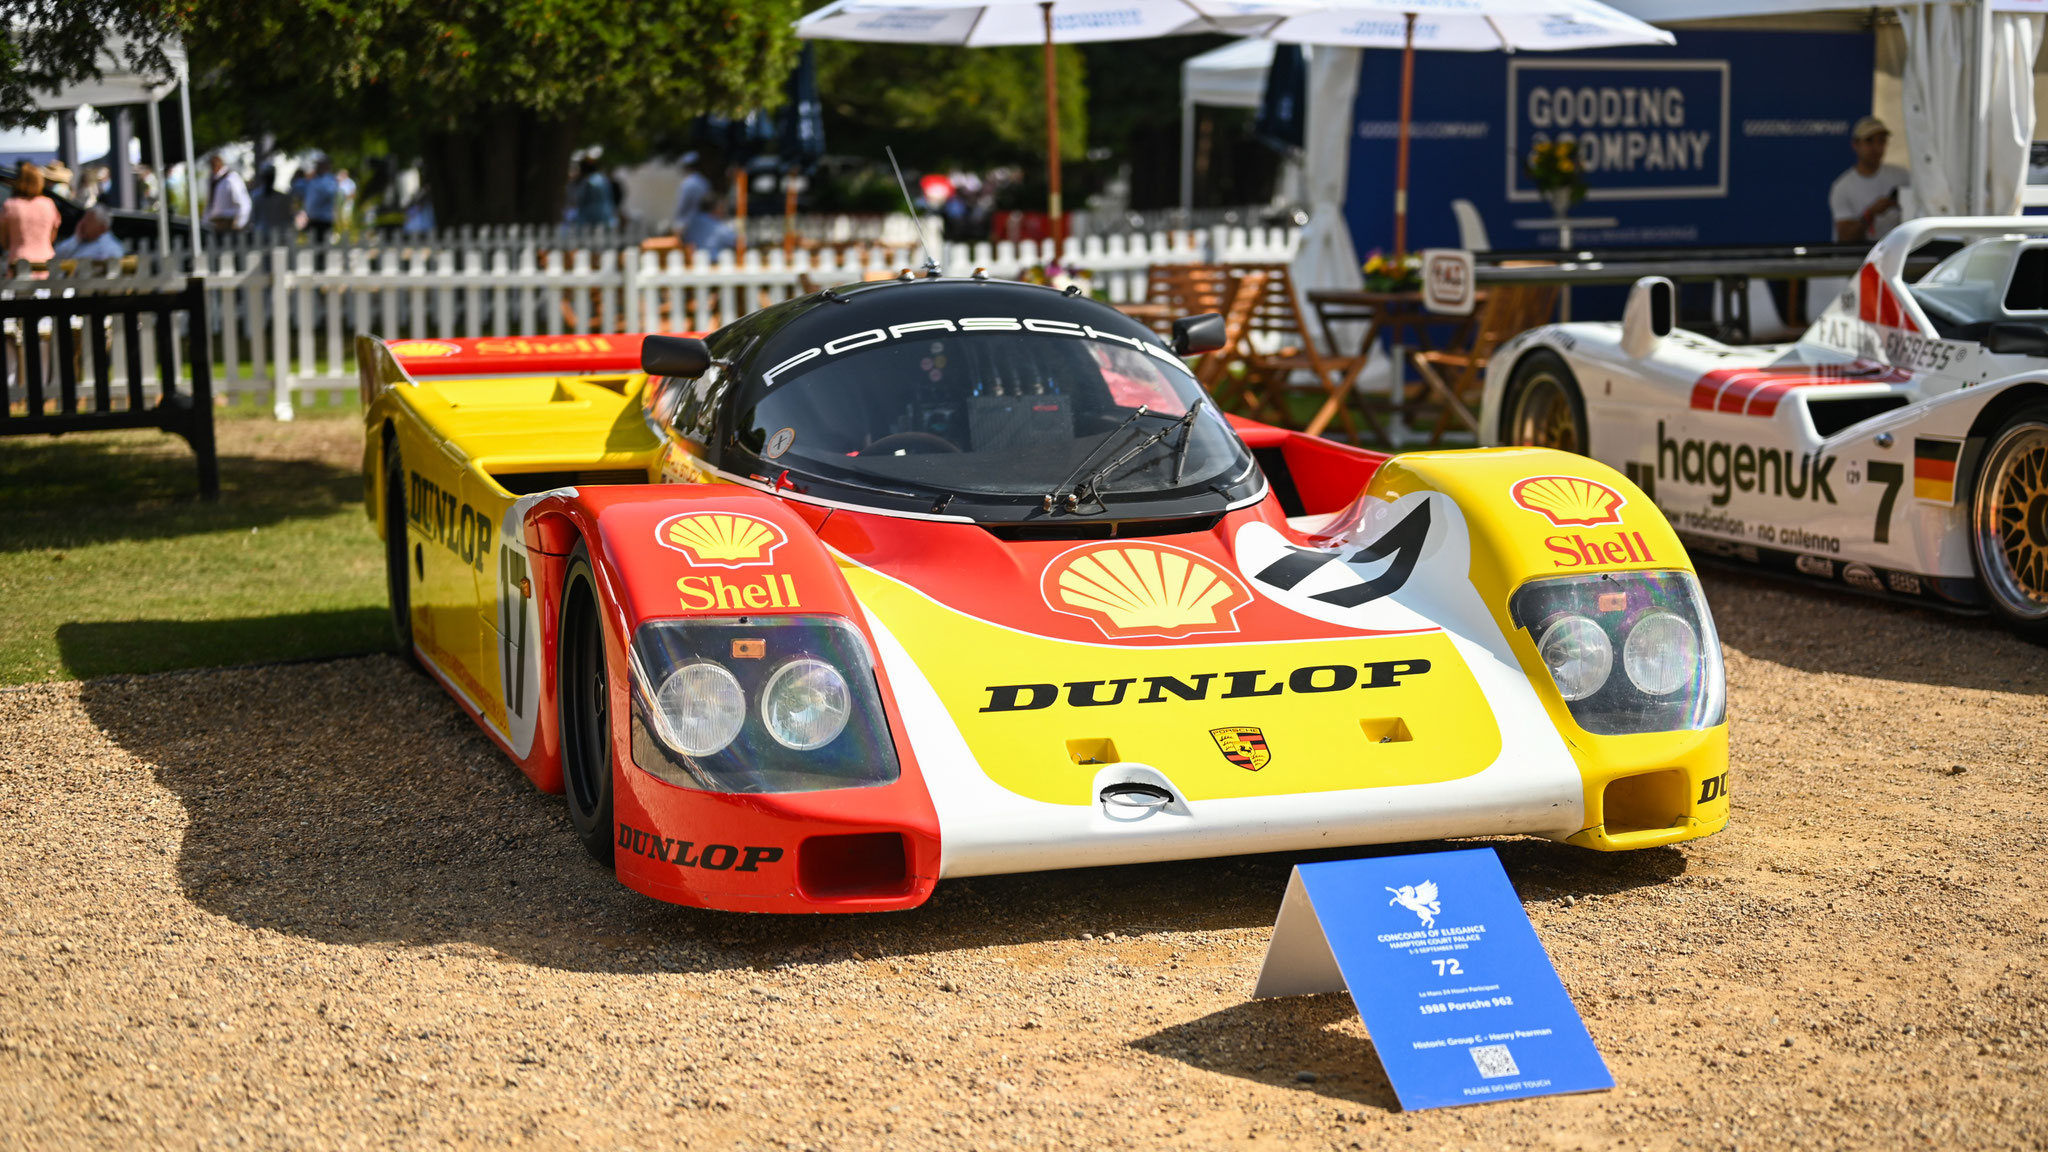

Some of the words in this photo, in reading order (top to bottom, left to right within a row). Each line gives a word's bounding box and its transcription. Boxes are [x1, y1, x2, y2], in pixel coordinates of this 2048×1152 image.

[1528, 87, 1685, 127] GOODING
[475, 338, 614, 355] Shell
[1656, 420, 1838, 506] hagenuk
[1866, 460, 1904, 544] 7
[411, 470, 492, 574] DUNLOP
[1685, 505, 1745, 536] radiation
[1757, 524, 1776, 541] no
[1780, 527, 1841, 553] antenna
[1545, 531, 1656, 568] Shell
[676, 574, 801, 610] Shell
[500, 543, 527, 720] 17
[978, 658, 1431, 713] DUNLOP
[618, 823, 784, 872] DUNLOP
[1377, 930, 1427, 942] CONCOURS
[1428, 929, 1440, 938] OF
[1441, 925, 1486, 936] ELEGANCE
[1389, 939, 1427, 949] HAMPTON
[1428, 937, 1452, 946] COURT
[1453, 934, 1481, 943] PALACE
[1420, 945, 1454, 954] SEPTEMBER
[1432, 958, 1464, 976] 72
[1420, 1003, 1447, 1015] 1988
[1448, 1000, 1491, 1012] Porsche
[1492, 996, 1514, 1007] 962
[1469, 984, 1500, 993] Participant
[1413, 1040, 1447, 1050] Historic
[1447, 1036, 1475, 1047] Group
[1475, 1035, 1483, 1043] C
[1489, 1031, 1515, 1041] Henry
[1515, 1028, 1552, 1038] Pearman
[1463, 1086, 1491, 1096] PLEASE
[1491, 1084, 1505, 1093] DO
[1505, 1081, 1522, 1091] NOT
[1523, 1079, 1552, 1089] TOUCH
